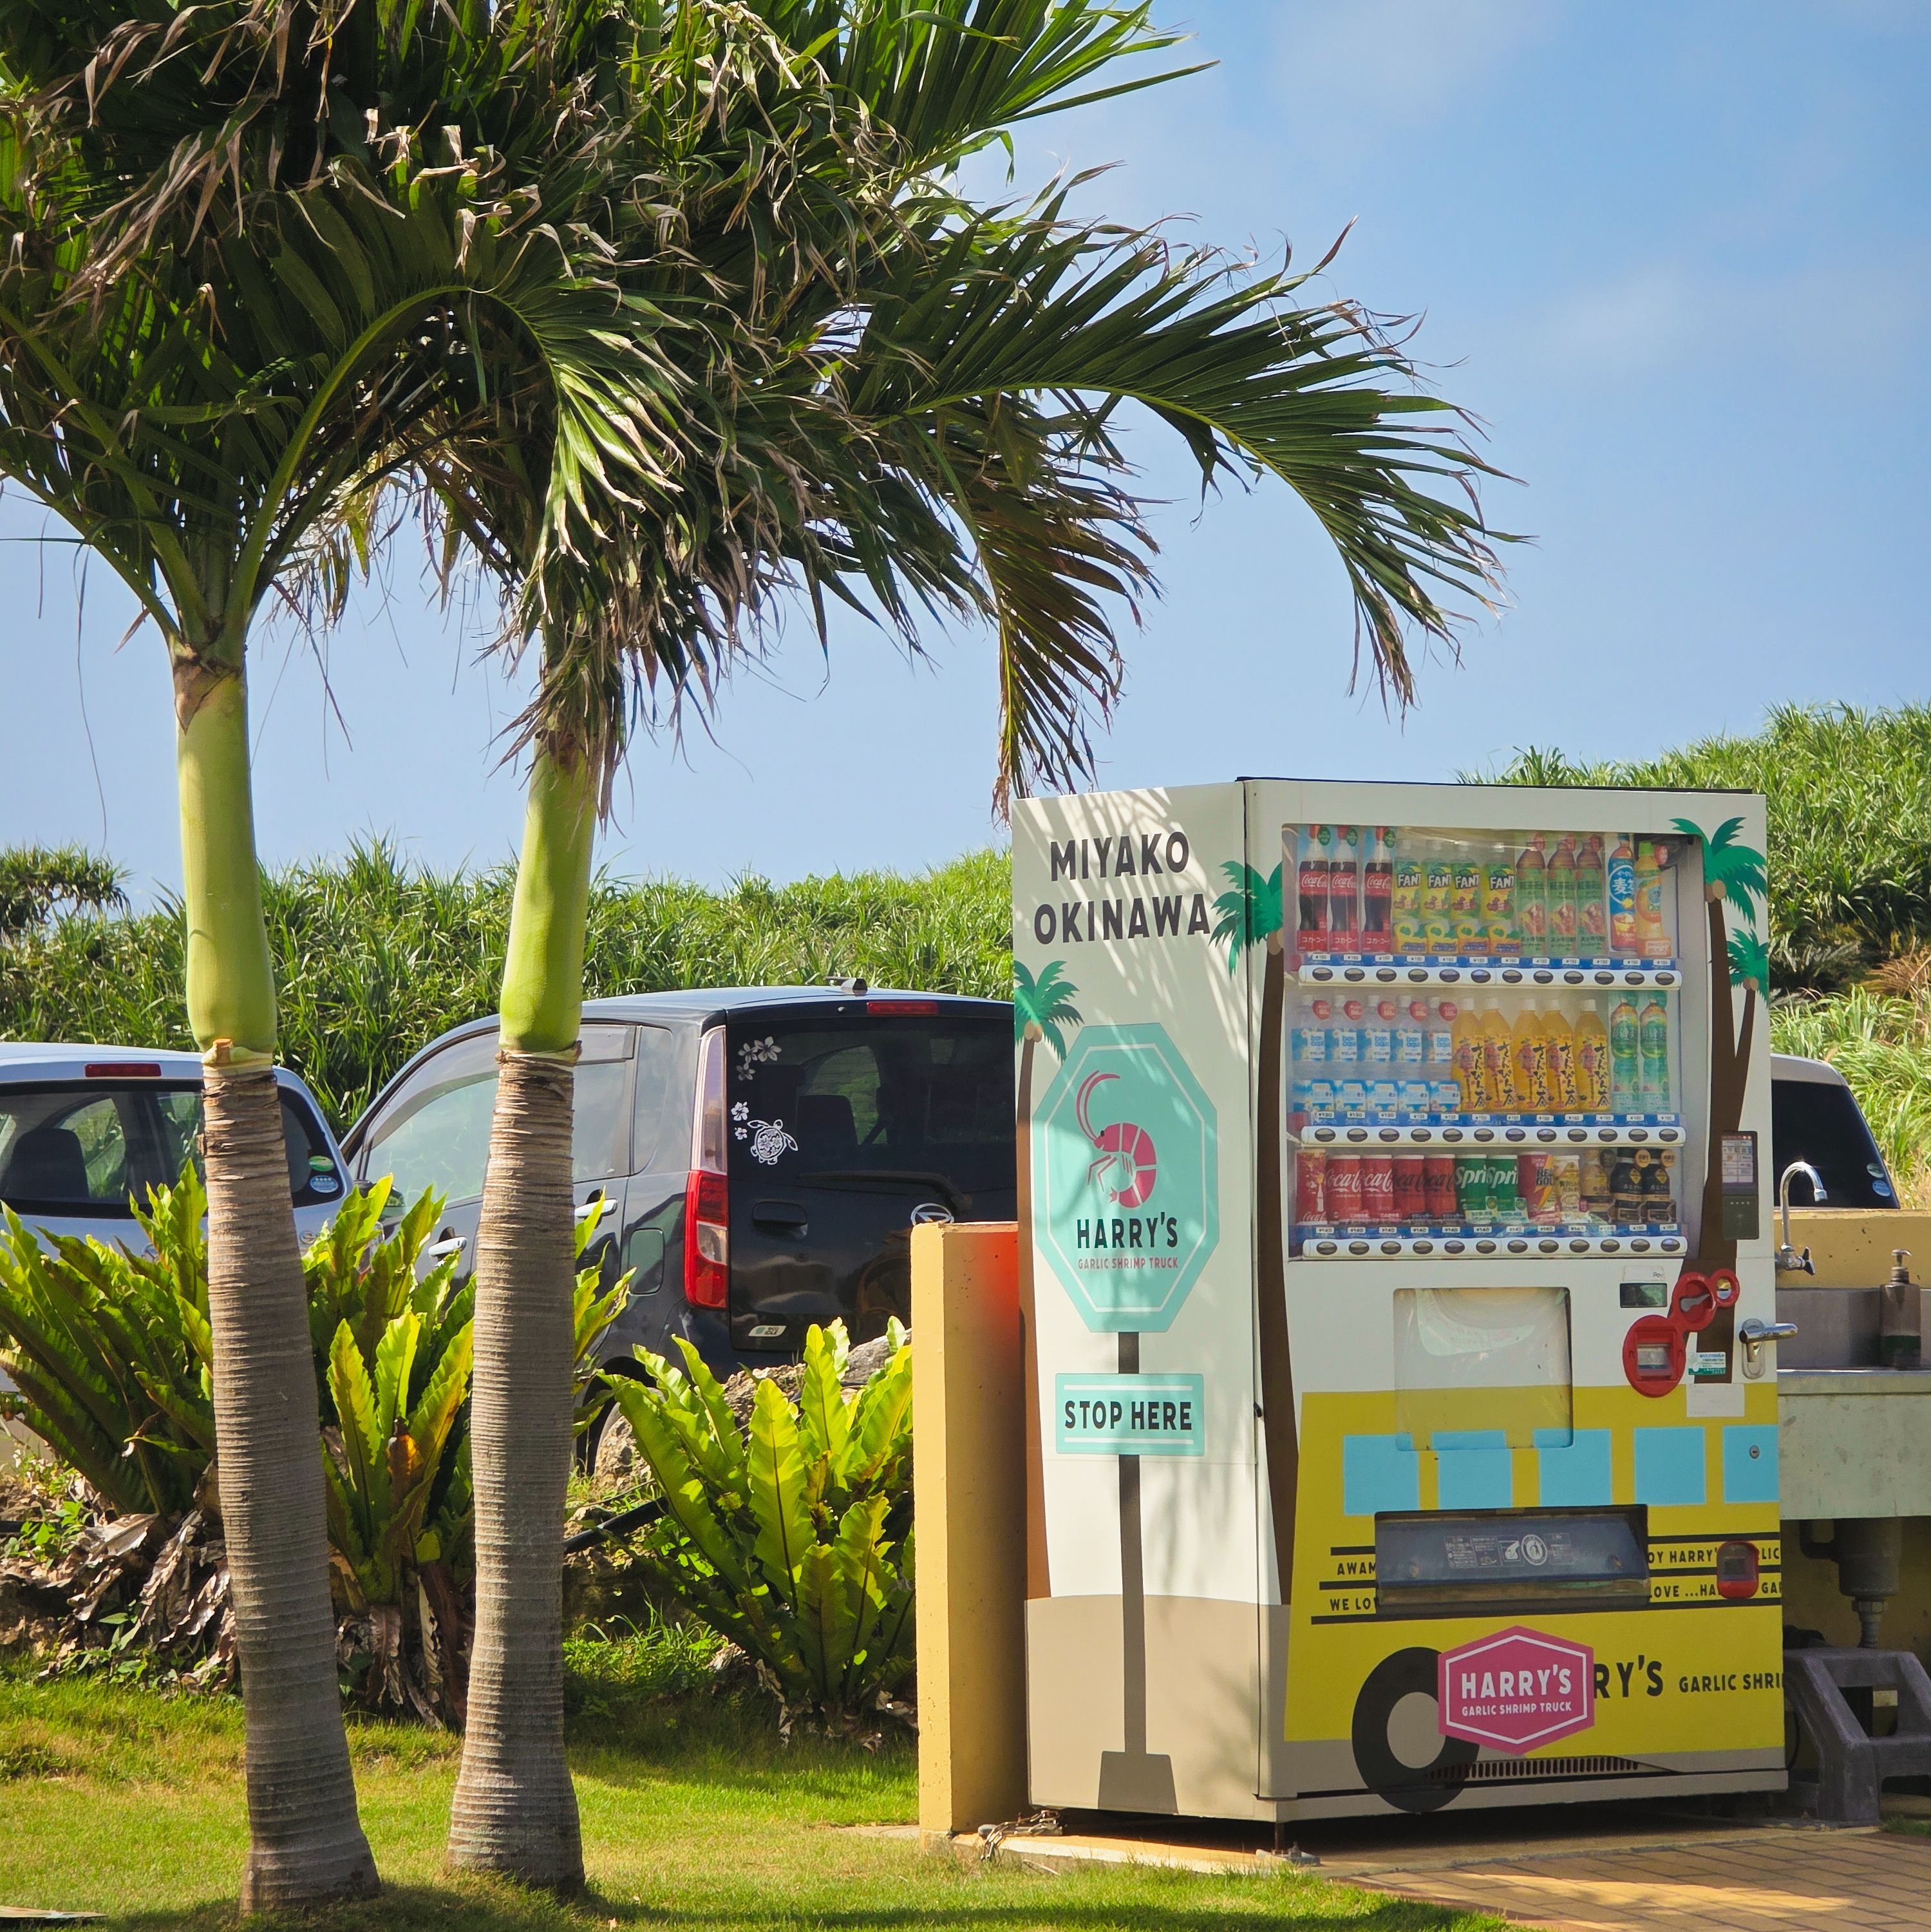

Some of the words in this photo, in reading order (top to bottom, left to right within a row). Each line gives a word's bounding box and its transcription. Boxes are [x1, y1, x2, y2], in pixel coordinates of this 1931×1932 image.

[1051, 831, 1190, 882] MIYAKO
[1034, 893, 1210, 945] OKINAWA
[1077, 1212, 1178, 1249] HARRY'S
[1078, 1258, 1109, 1269] GARLIC
[1112, 1257, 1145, 1269] SHRIMP
[1149, 1257, 1178, 1268] TRUCK
[1065, 1400, 1122, 1429] STOP
[1131, 1401, 1192, 1430] HERE
[1758, 1548, 1780, 1560] LIC
[1650, 1585, 1679, 1598] OVE
[1330, 1598, 1349, 1611] WE
[1462, 1664, 1572, 1699] HARRY'S
[1679, 1674, 1737, 1693] GARLIC
[1742, 1672, 1783, 1690] SHRI
[1462, 1705, 1496, 1716] GARLIC
[1499, 1703, 1537, 1714] SHRIMP
[1540, 1701, 1572, 1712] TRUCK
